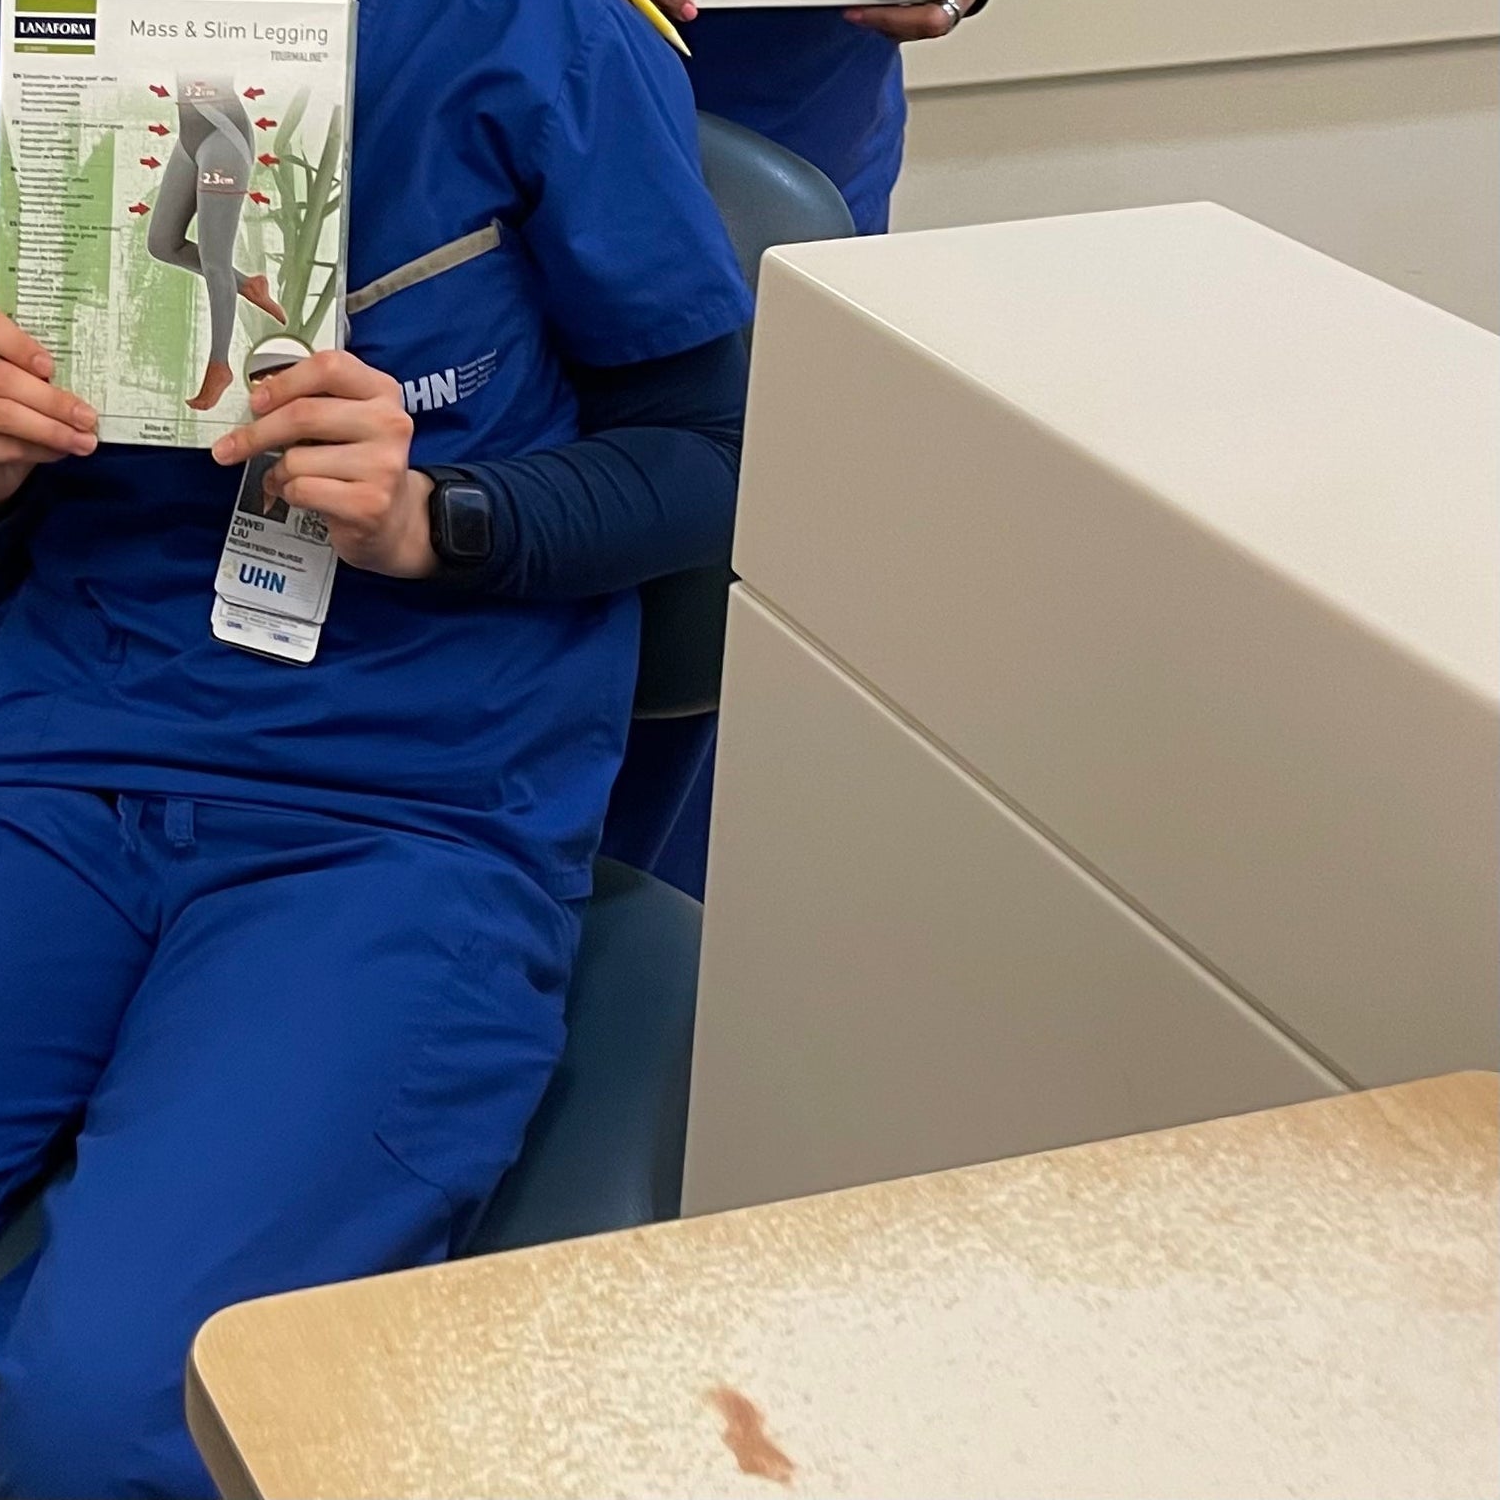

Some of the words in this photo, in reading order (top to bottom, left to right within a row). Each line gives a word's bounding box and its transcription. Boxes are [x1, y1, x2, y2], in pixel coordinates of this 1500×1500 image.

[20, 21, 91, 35] LANAFORM
[130, 19, 178, 38] Mass
[184, 20, 198, 37] &
[204, 19, 246, 40] Slim
[253, 22, 328, 46] Legging
[401, 368, 457, 414] HN
[231, 526, 249, 539] LIU
[239, 563, 287, 594] UHN
